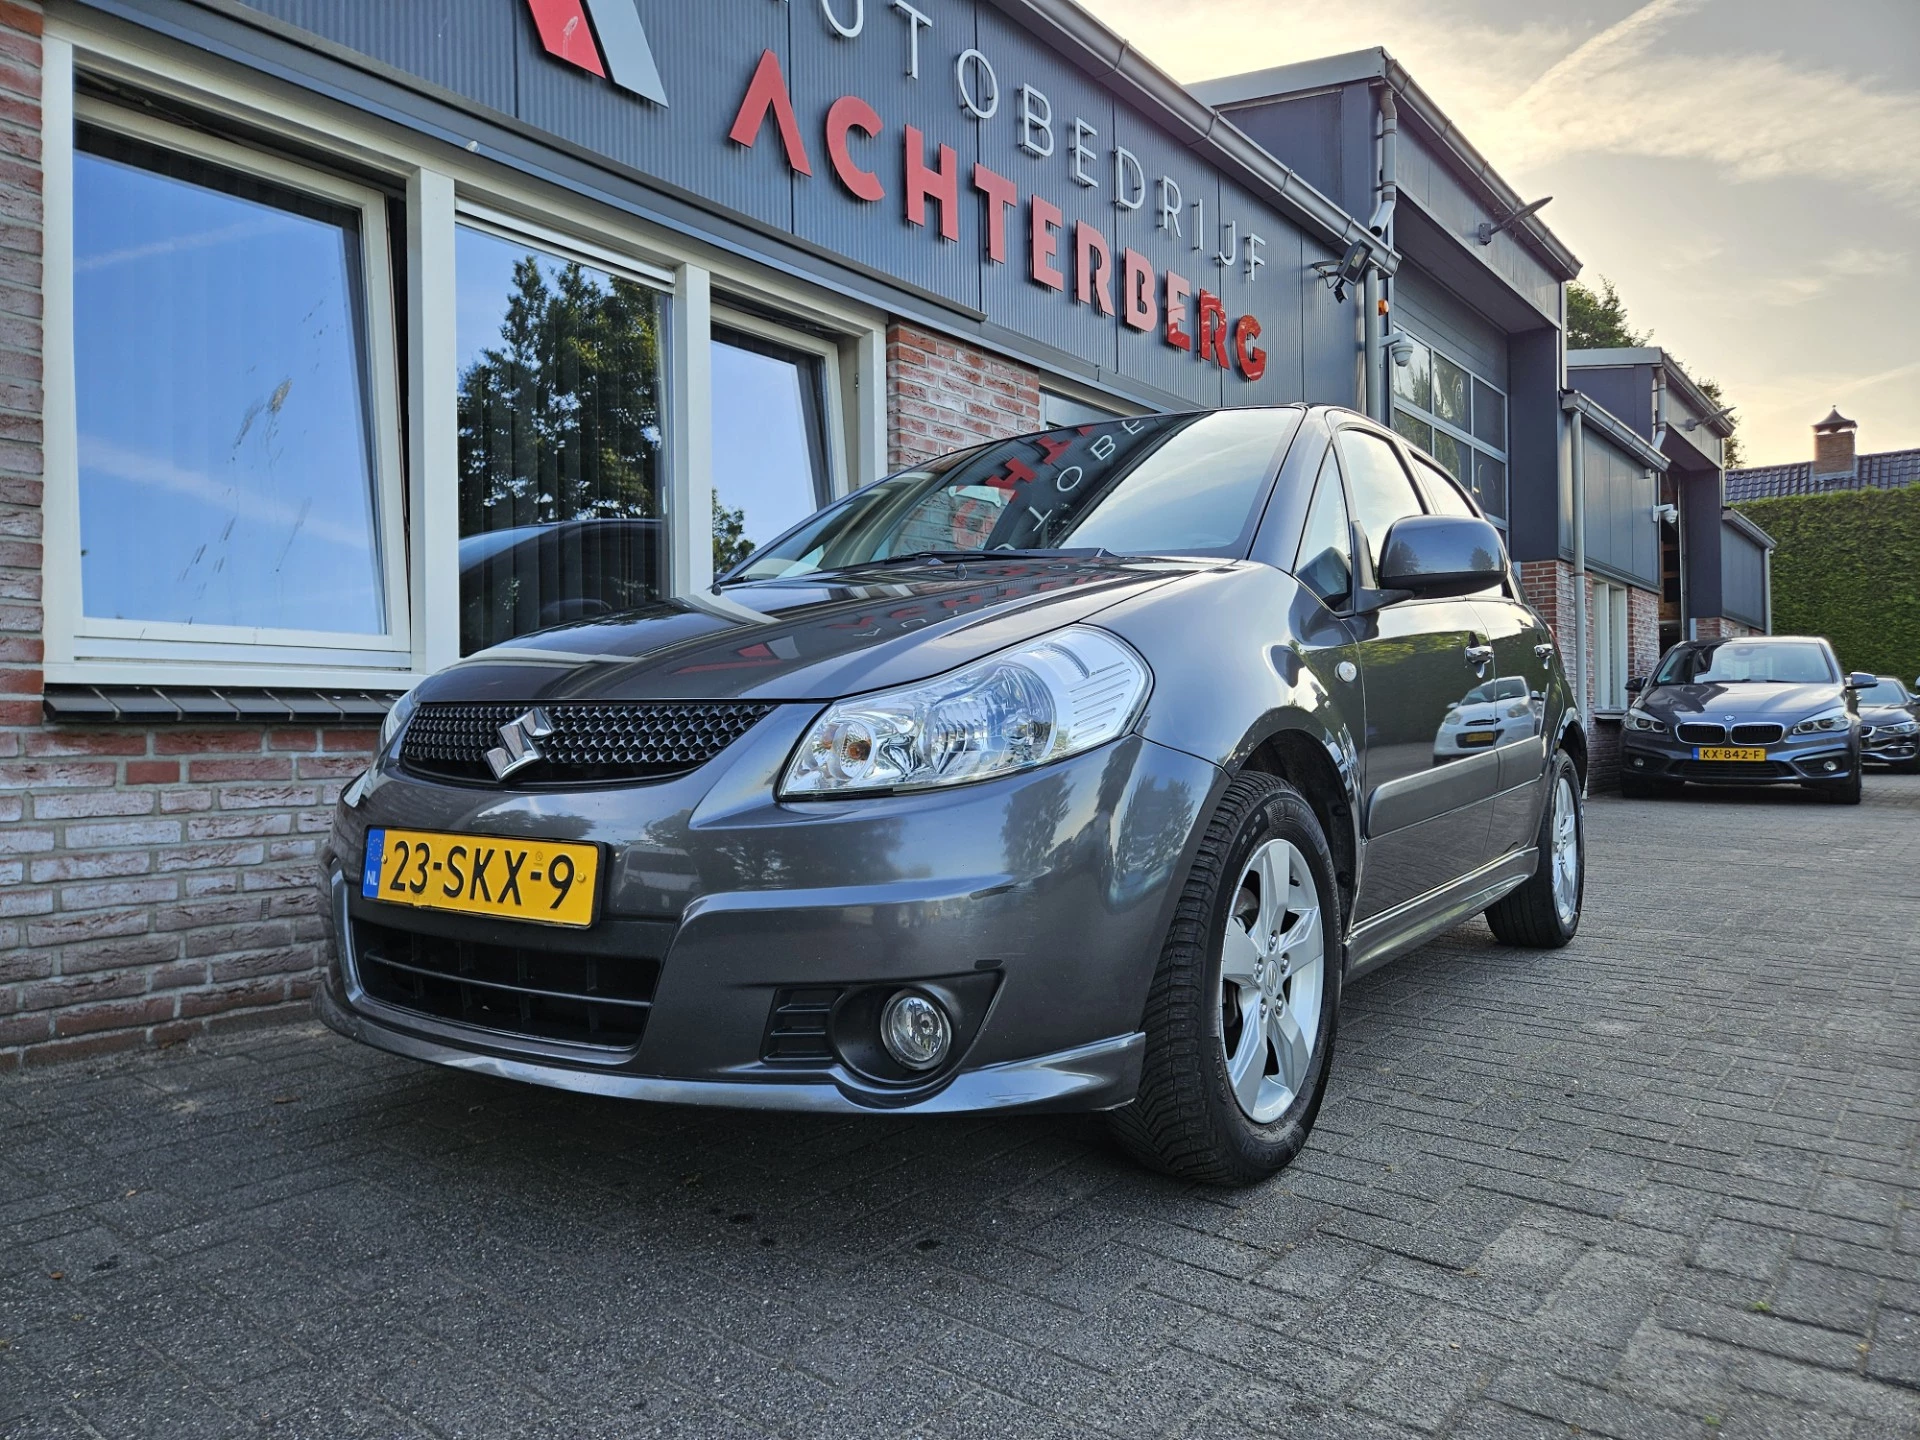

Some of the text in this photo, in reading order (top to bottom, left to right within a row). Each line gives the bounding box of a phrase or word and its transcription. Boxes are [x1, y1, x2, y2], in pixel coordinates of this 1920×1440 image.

[783, 0, 1266, 281] TOBEDRIJF
[729, 48, 1267, 382] ACHTERBERG
[1703, 749, 1760, 759] KX-842-F
[366, 870, 378, 886] NL
[389, 840, 575, 910] 23-SKX-9
